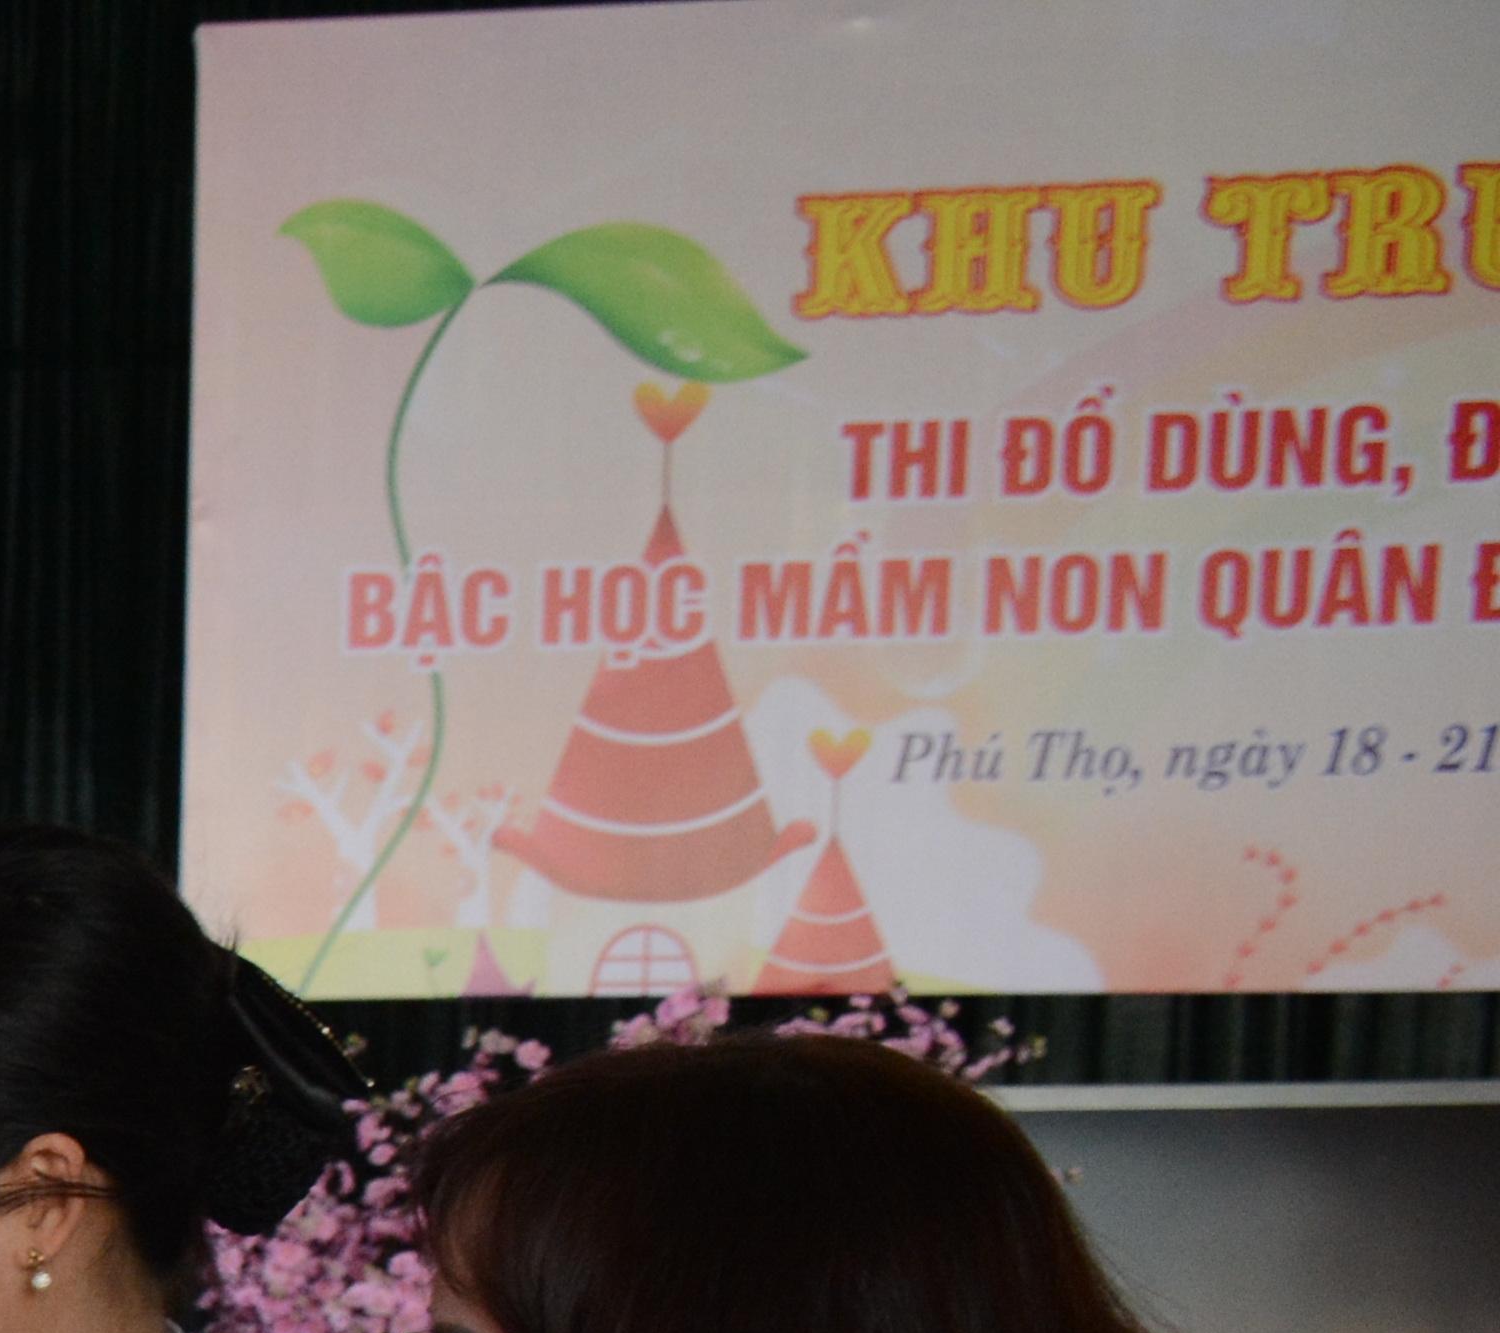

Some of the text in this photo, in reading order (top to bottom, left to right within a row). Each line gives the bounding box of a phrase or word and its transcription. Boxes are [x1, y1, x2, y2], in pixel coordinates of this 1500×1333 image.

[792, 179, 1163, 319] KHU
[842, 420, 969, 499] THI
[1003, 385, 1115, 495] ĐỒ
[1148, 392, 1413, 497] DÙNG,
[347, 552, 509, 667] BẬC
[541, 565, 706, 663] HỌC
[738, 529, 951, 640] MẦM
[984, 552, 1168, 635] NON
[1200, 528, 1442, 639] QUÂN
[892, 730, 1004, 784] Phú
[1029, 730, 1145, 795] Thọ,
[1164, 731, 1305, 790] ngày
[1322, 725, 1387, 777] 18
[1433, 725, 1500, 773] 21
